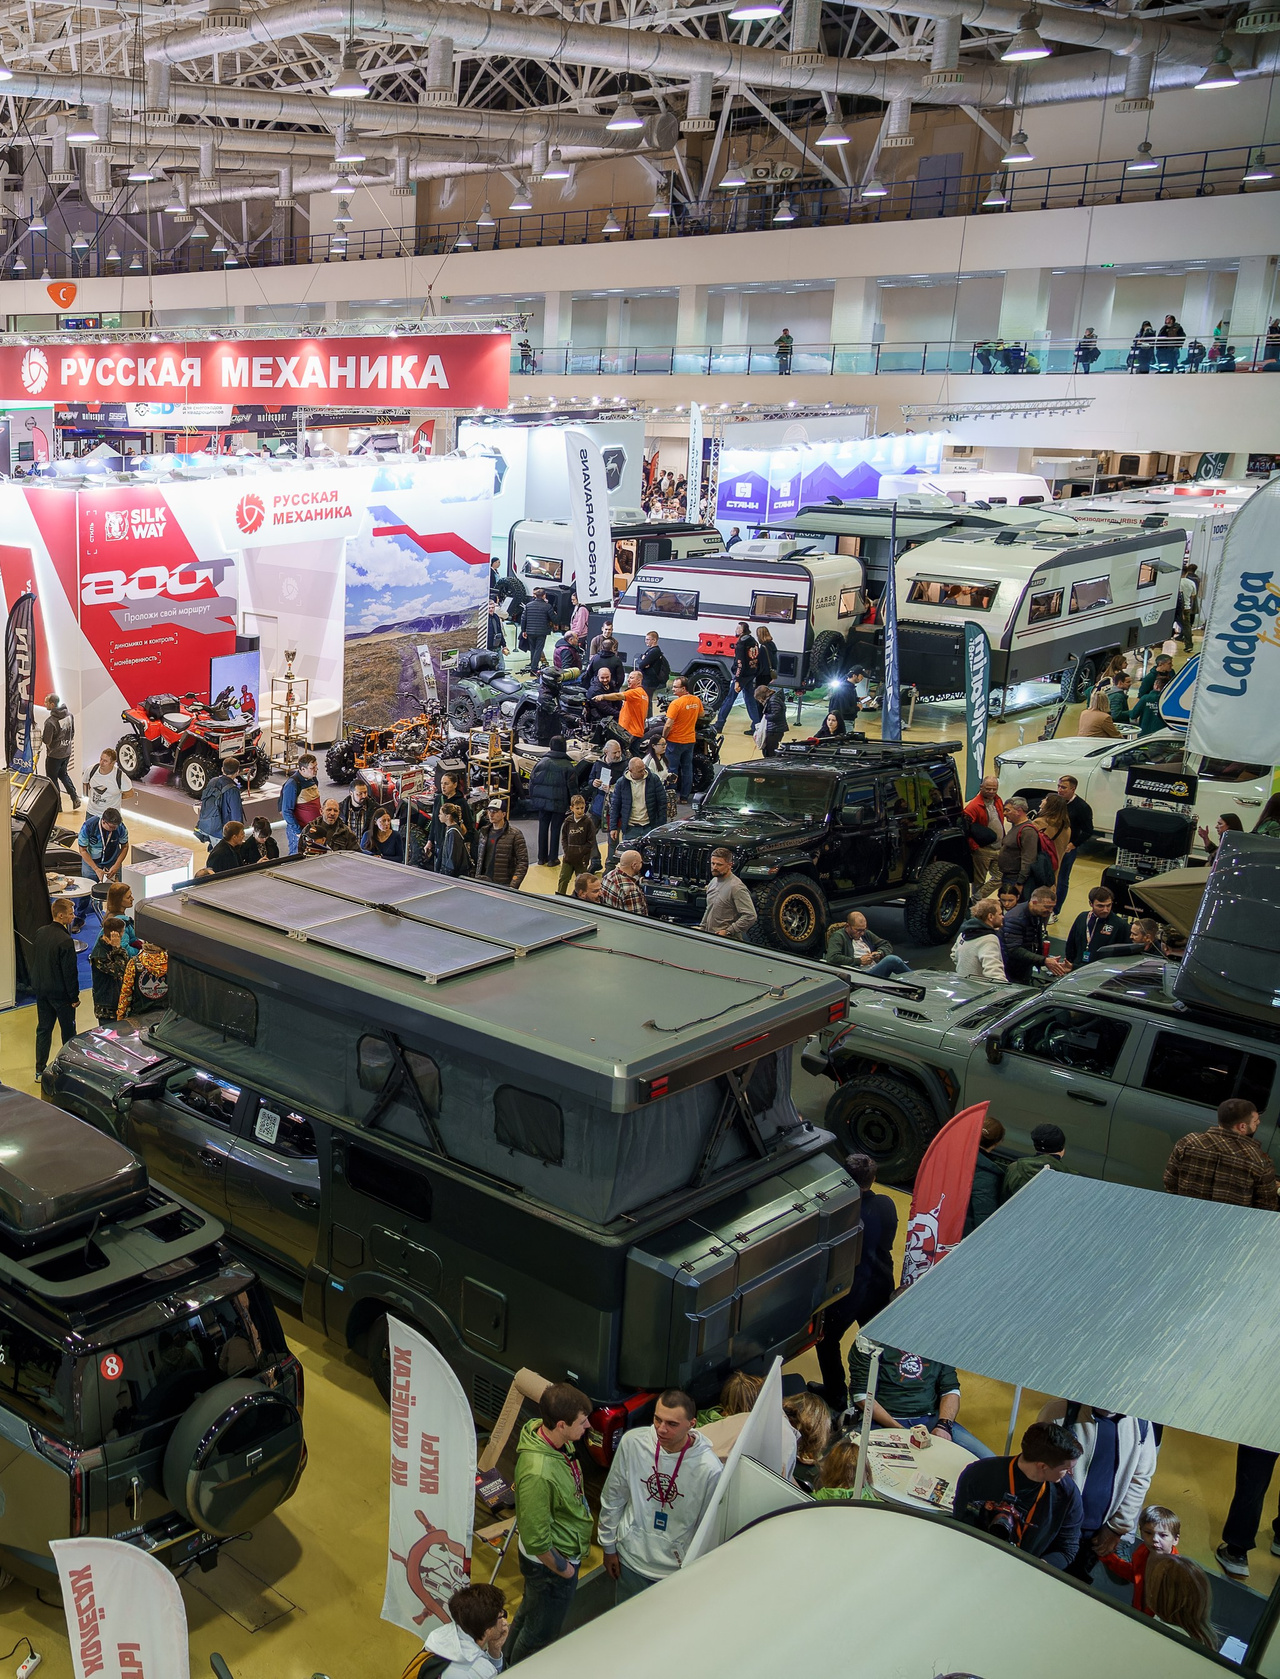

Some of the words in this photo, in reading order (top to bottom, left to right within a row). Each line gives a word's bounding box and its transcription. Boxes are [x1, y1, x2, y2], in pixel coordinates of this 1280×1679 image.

[61, 357, 201, 387] РУССКАЯ
[222, 354, 449, 389] МЕХАНИКА
[273, 490, 339, 508] РУССКАЯ
[131, 507, 166, 523] SILK
[273, 506, 352, 526] МЕХАНИКА
[131, 522, 166, 538] WAY
[124, 610, 158, 623] Проложи
[160, 607, 177, 617] свой
[178, 604, 211, 618] маршрут
[1206, 571, 1274, 696] Ladoga
[105, 1356, 120, 1377] 8
